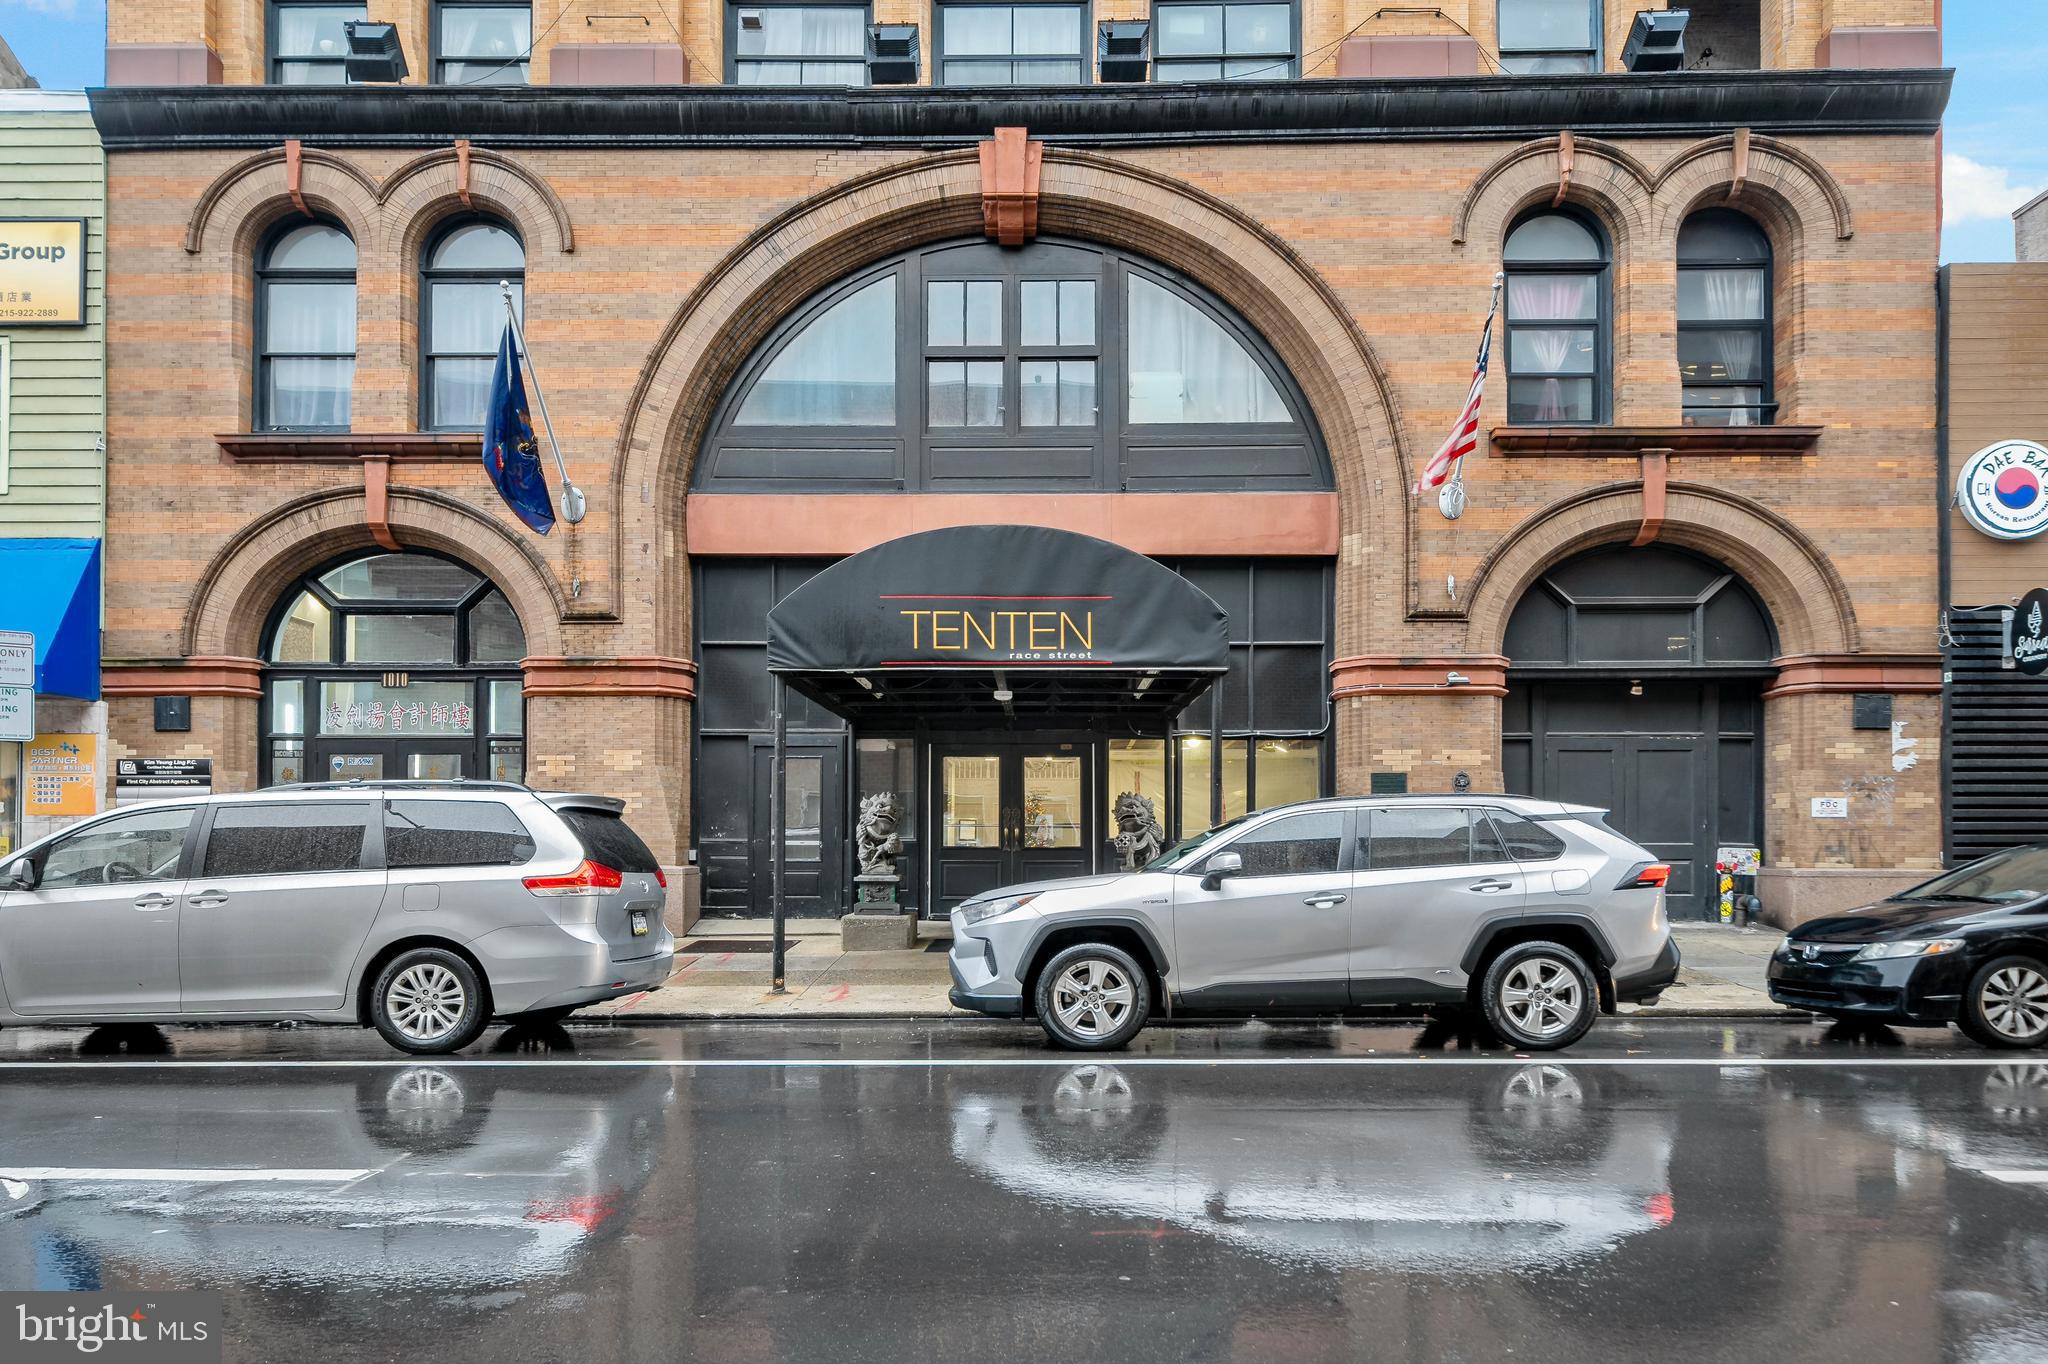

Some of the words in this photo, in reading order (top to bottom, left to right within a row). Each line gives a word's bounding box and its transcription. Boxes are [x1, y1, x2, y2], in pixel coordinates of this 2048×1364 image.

[0, 242, 66, 263] Group
[1982, 451, 2015, 475] DAE
[900, 610, 1092, 650] TENTEN
[0, 648, 27, 658] ONLY
[1009, 651, 1041, 659] race
[1049, 651, 1092, 659] street
[383, 672, 408, 687] 1010
[0, 688, 18, 696] ING
[0, 705, 18, 713] ING
[325, 700, 472, 730] 凌劍揚會計師樓
[31, 748, 57, 756] BEST
[31, 756, 78, 764] PARTNER
